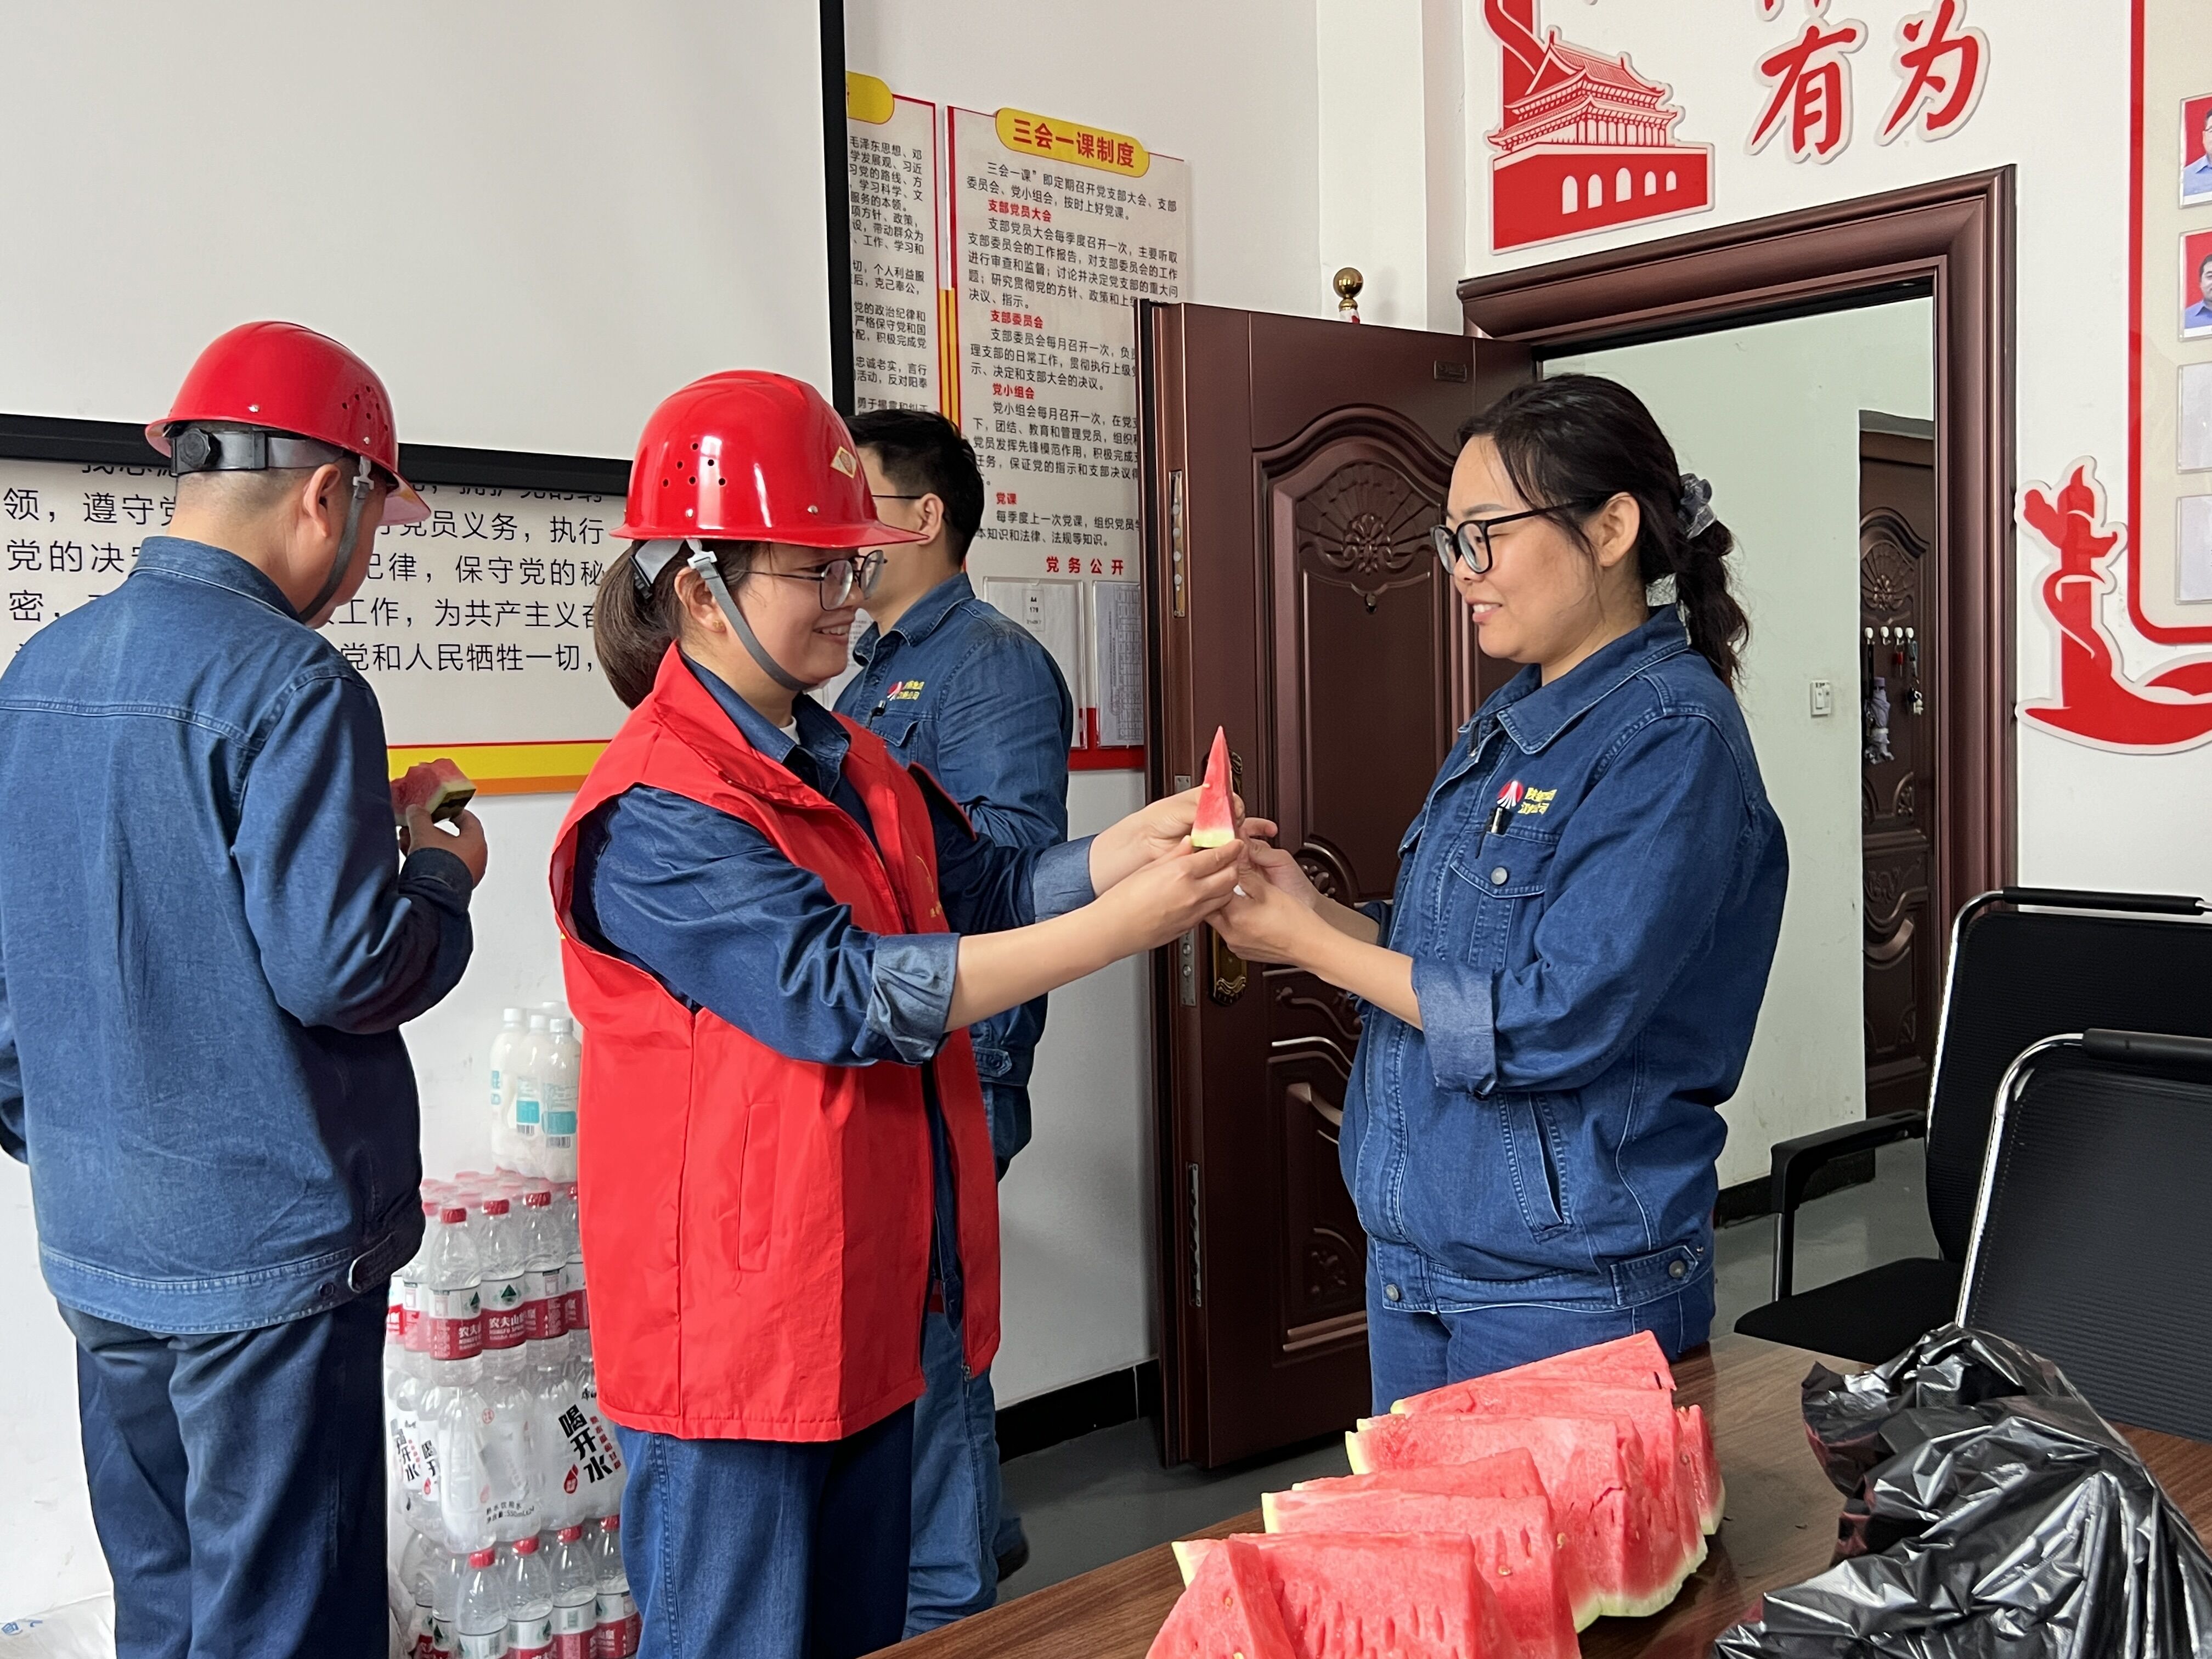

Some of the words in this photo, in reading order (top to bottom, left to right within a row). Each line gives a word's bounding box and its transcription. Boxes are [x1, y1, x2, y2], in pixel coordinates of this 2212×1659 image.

[1752, 0, 1978, 155] 有为
[850, 136, 922, 160] 毛泽东思想、邓
[1013, 119, 1135, 168] 三会一课制度
[850, 150, 922, 175] 学发展观、习近
[849, 164, 922, 188] 习党的路线、方
[851, 191, 906, 212] 服务的本领。
[988, 199, 1052, 223] 支部党员大会
[968, 288, 1029, 309] 决议、指示。
[854, 301, 926, 322] 党的政治纪律和
[990, 310, 1043, 329] 支部委员会
[855, 315, 926, 336] 严格保守党和国
[853, 329, 927, 349] 配，积极完成党
[856, 357, 927, 376] 忠诚老实，言行
[992, 383, 1035, 400] 党小组会
[996, 492, 1017, 505] 党课
[7, 539, 140, 573] 党的决
[1046, 556, 1124, 575] 党务公开
[328, 597, 596, 628] 工作，为共产主义
[558, 1404, 613, 1483] 喝开水
